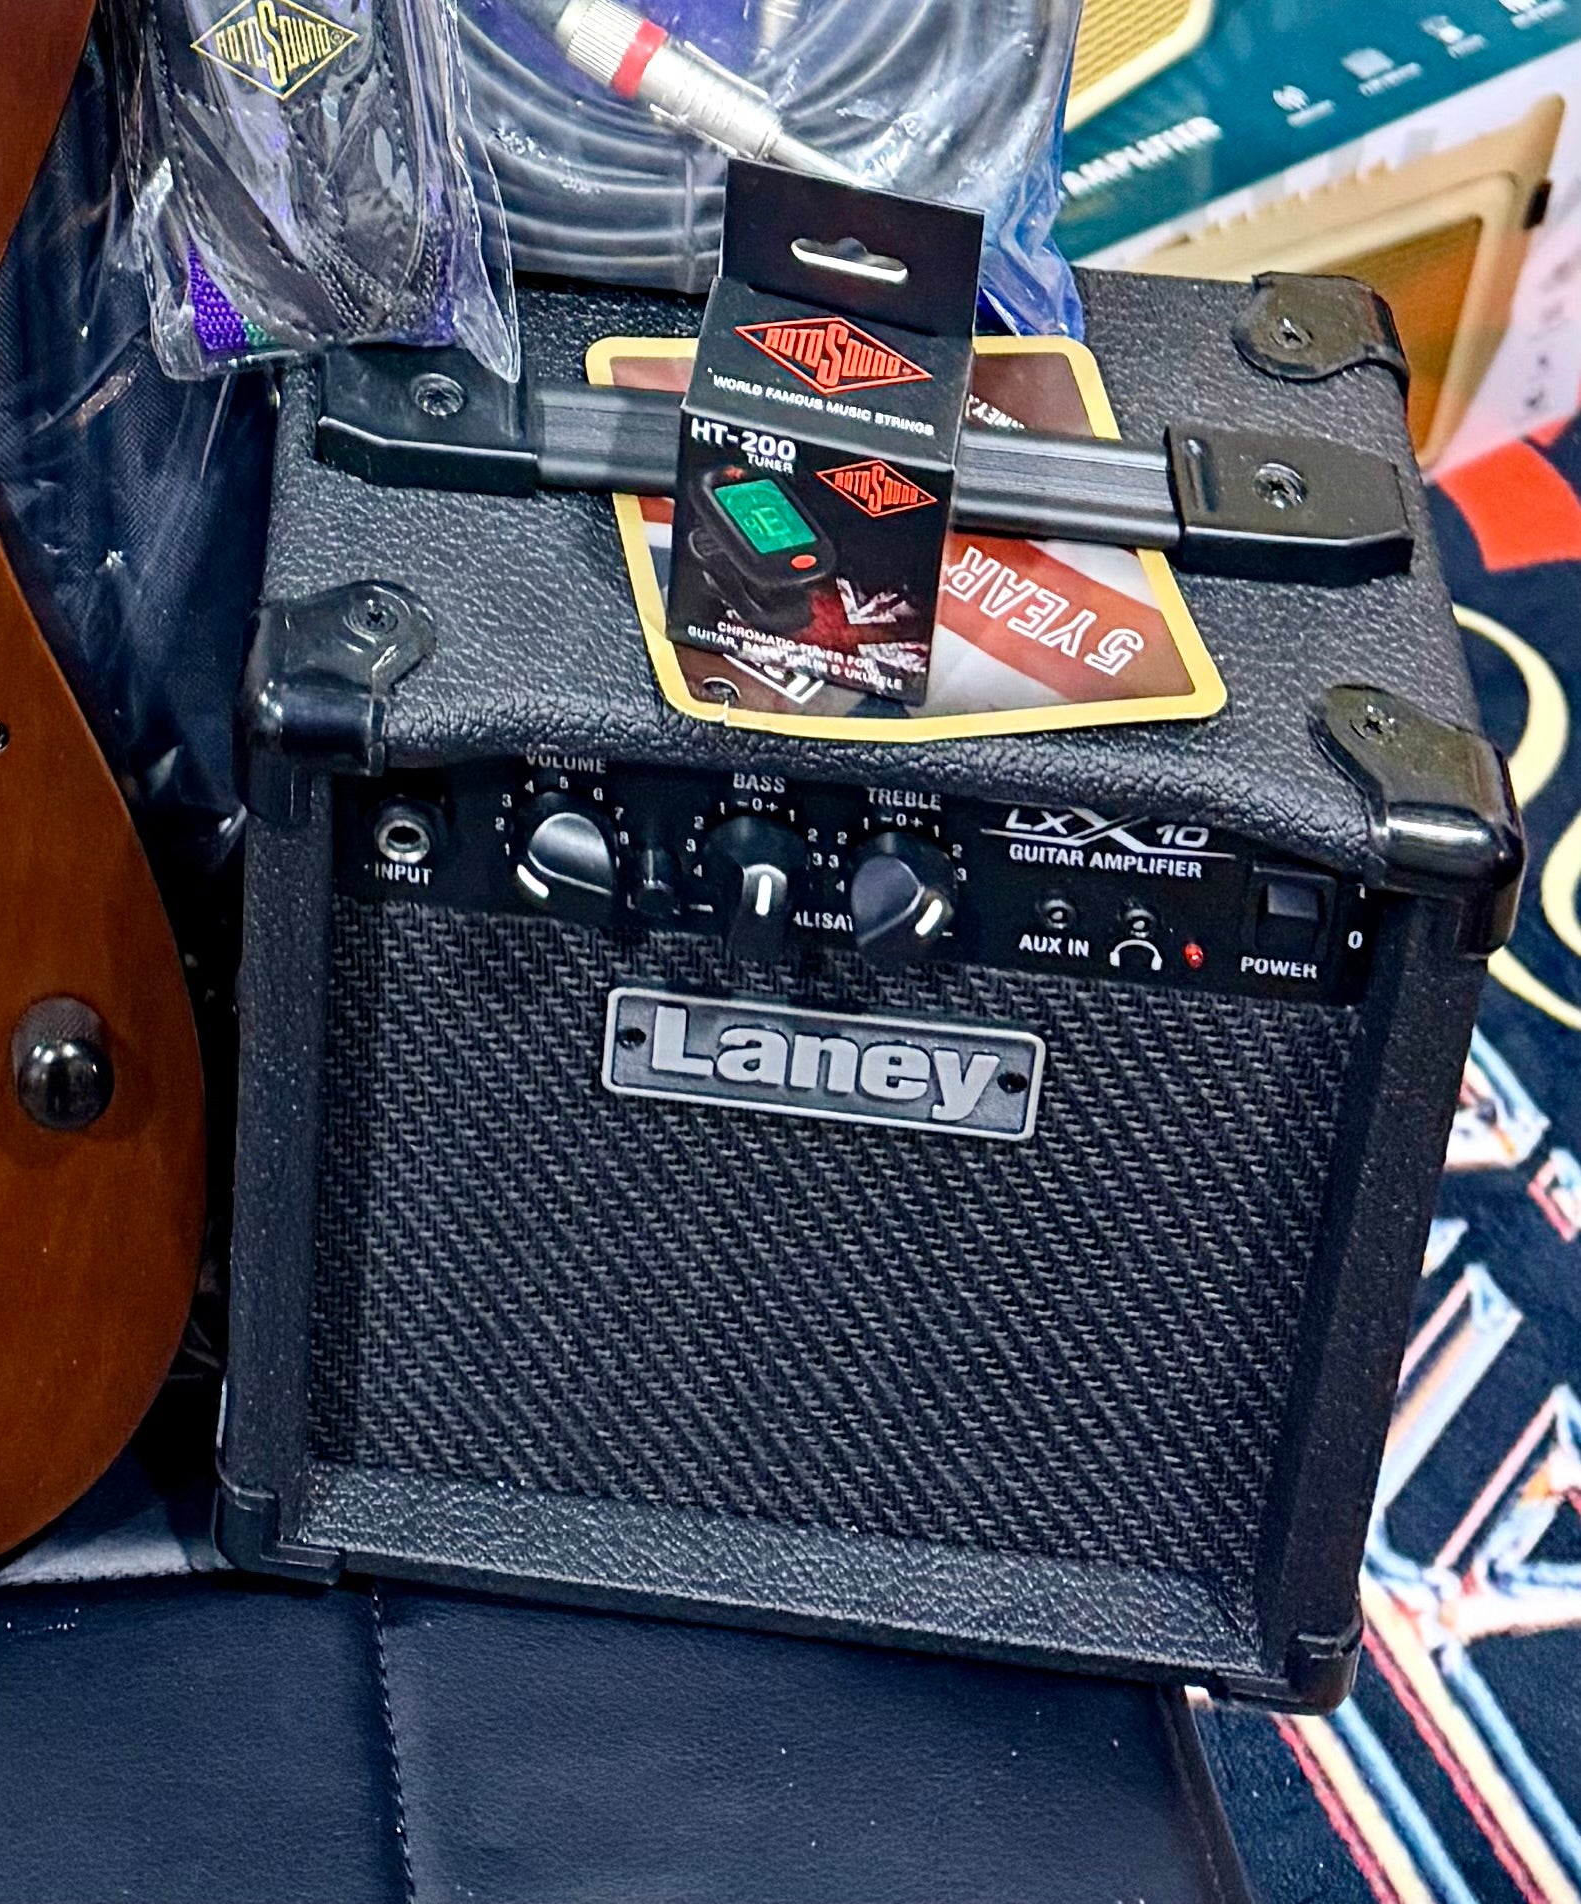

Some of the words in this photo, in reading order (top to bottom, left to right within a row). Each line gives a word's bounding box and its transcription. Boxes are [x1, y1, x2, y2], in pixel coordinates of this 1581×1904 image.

[714, 375, 762, 396] WORLD
[766, 387, 822, 409] FAMOUS
[827, 402, 871, 421] MUSIC
[875, 412, 934, 436] STRINGS
[691, 418, 796, 461] HT-200
[747, 452, 793, 474] TUNER
[718, 622, 795, 652] CHROMATIC
[800, 643, 844, 664] TUNER
[1086, 628, 1144, 675] 5
[526, 755, 606, 774] VOLUME
[733, 773, 786, 793] BASS
[495, 817, 505, 831] 2
[502, 794, 512, 807] 3
[525, 780, 534, 793] 4
[559, 776, 569, 789] 5
[593, 787, 603, 801] 6
[868, 787, 942, 811] TREBLE
[694, 816, 704, 829] 2
[686, 839, 696, 852] 3
[808, 829, 818, 842] 2
[837, 832, 847, 845] 2
[1156, 824, 1209, 848] 10
[693, 864, 702, 877] 4
[829, 855, 839, 868] 3
[1009, 844, 1084, 867] GUITAR
[1089, 852, 1202, 878] AMPLIFIER
[375, 862, 432, 885] INPUT
[836, 880, 845, 893] 4
[1019, 934, 1063, 955] AUX
[1068, 938, 1089, 958] IN
[1241, 956, 1317, 979] POWER
[652, 1005, 1000, 1122] Laney
